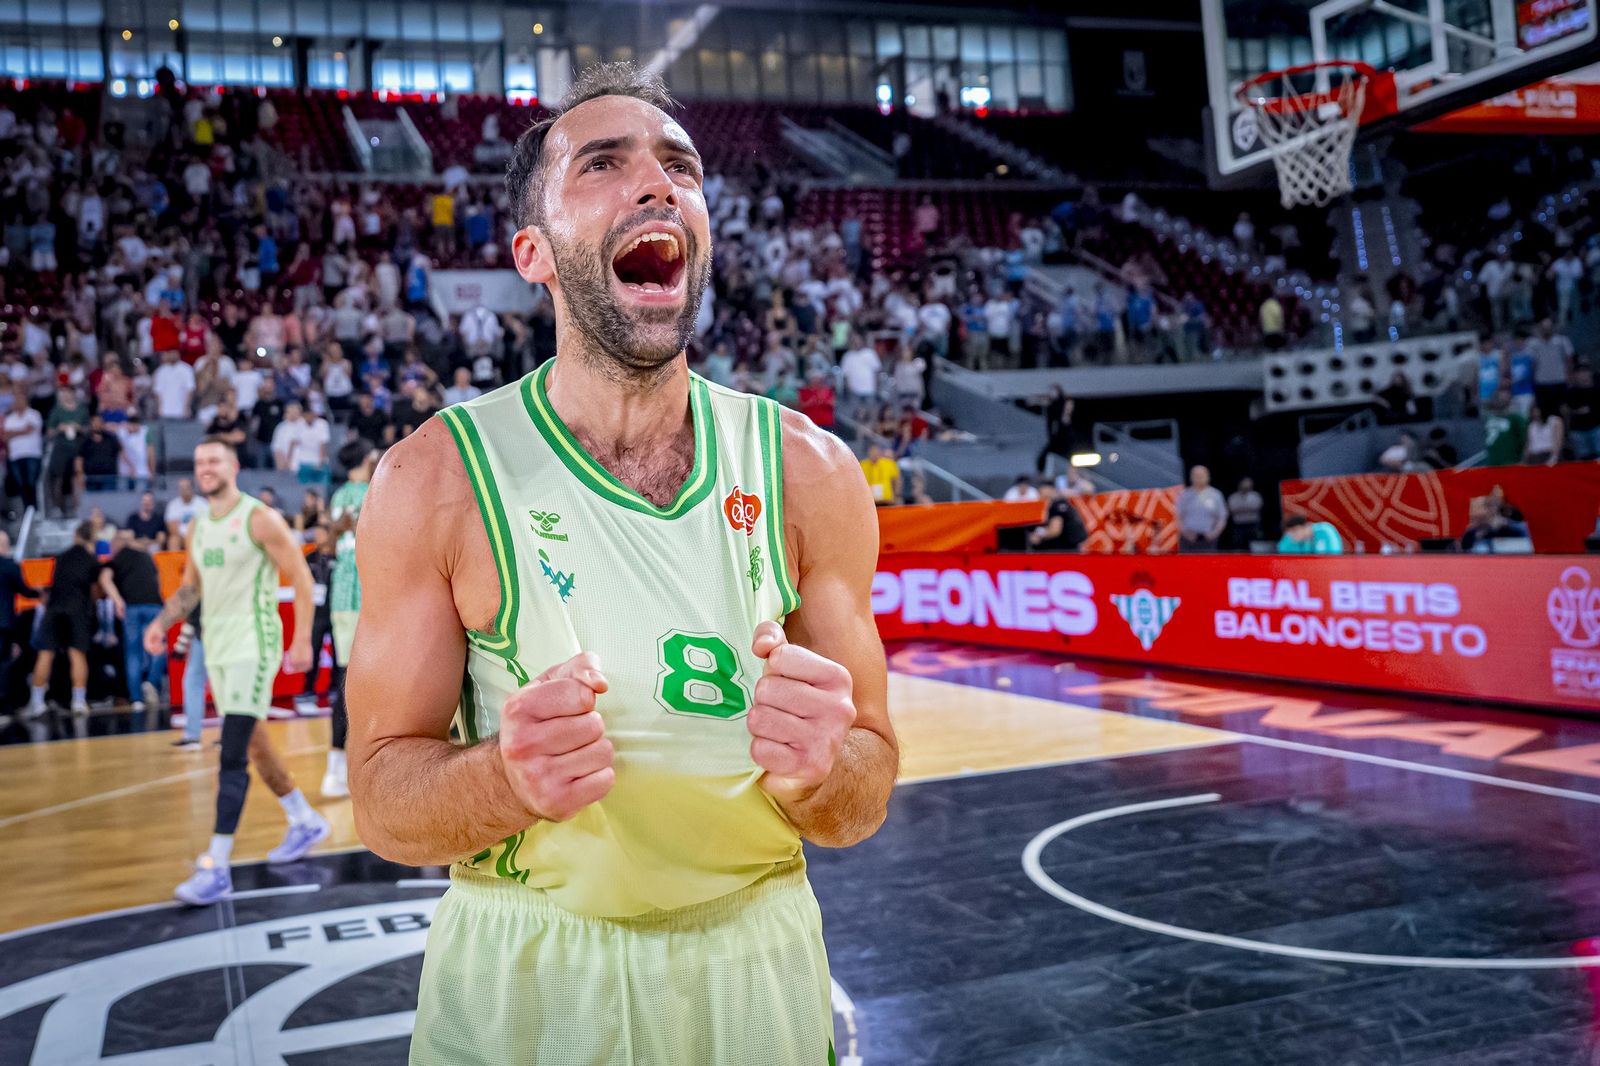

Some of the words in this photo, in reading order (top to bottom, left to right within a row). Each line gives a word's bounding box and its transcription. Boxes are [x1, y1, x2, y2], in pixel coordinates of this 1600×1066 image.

[1227, 577, 1323, 610] REAL
[1330, 580, 1461, 617] BETIS
[1214, 610, 1488, 657] BALONCESTO
[654, 629, 753, 721] 8
[266, 911, 432, 950] FEB
